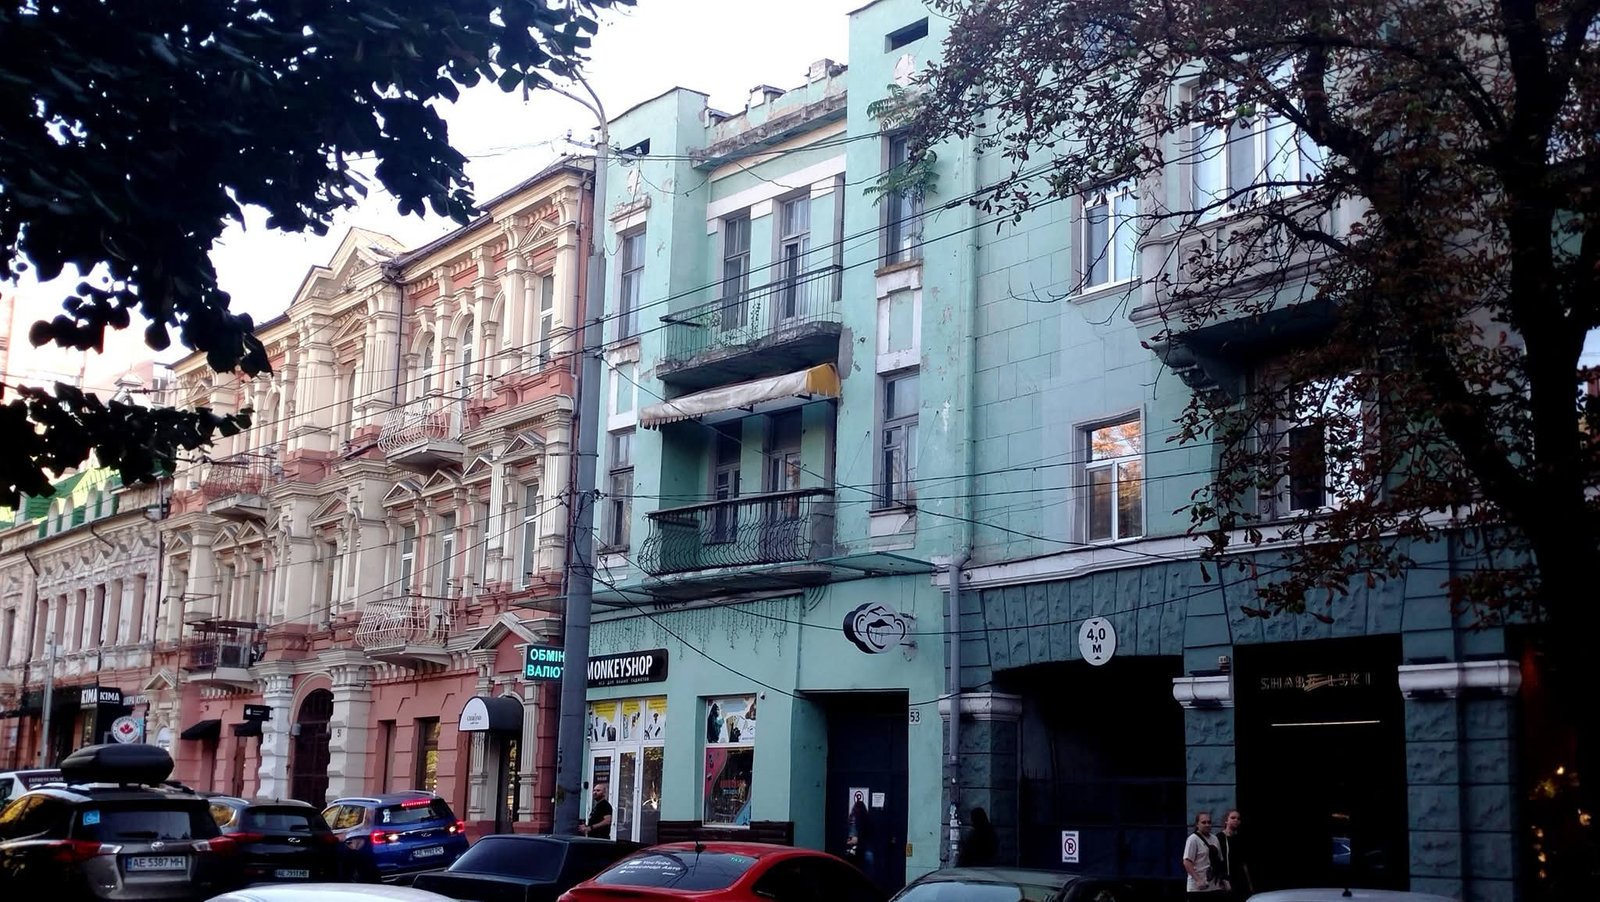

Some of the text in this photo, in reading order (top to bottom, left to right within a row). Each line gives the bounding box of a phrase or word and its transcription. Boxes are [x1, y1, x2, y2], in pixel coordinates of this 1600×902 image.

[1087, 627, 1106, 643] 4,0
[1092, 644, 1102, 654] М
[587, 655, 653, 680] MONKEYSHOP
[100, 692, 120, 701] KIMA
[910, 711, 920, 723] 53
[133, 857, 146, 868] AE
[171, 856, 184, 867] MH
